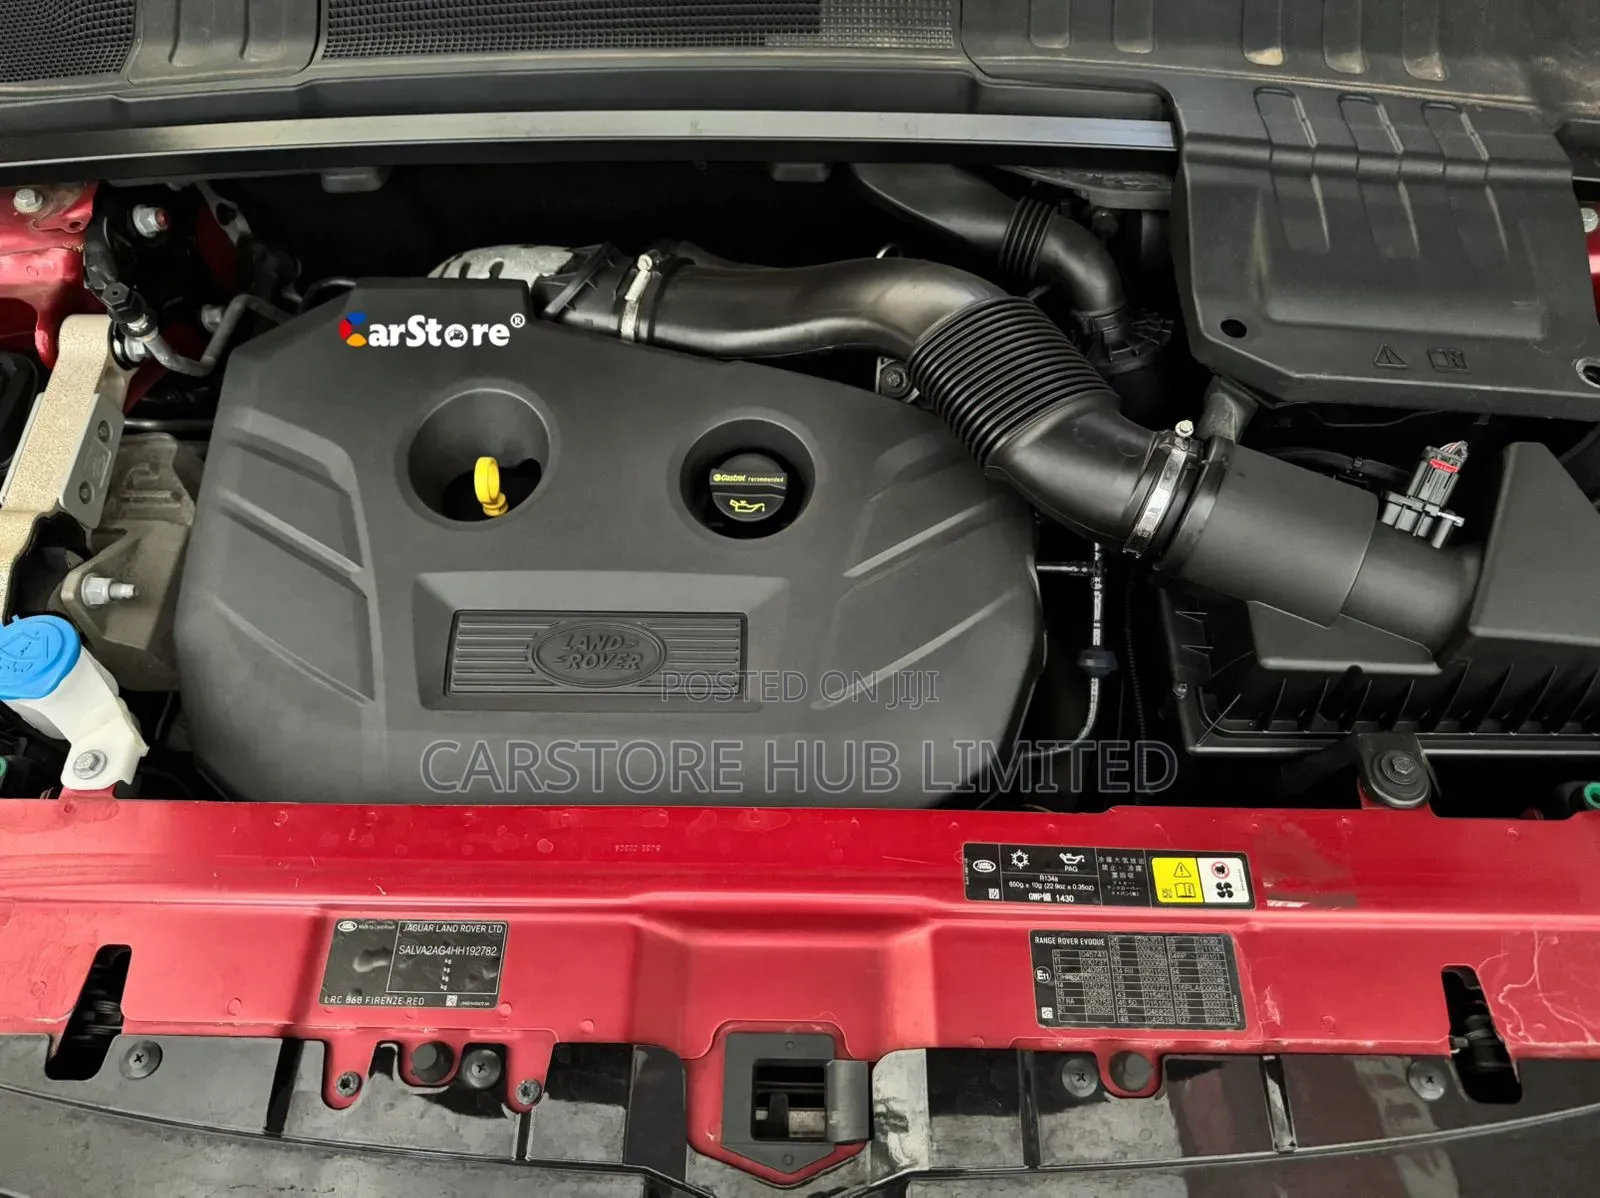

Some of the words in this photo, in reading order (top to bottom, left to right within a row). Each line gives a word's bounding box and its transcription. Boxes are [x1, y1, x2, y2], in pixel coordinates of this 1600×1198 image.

[721, 474, 746, 482] Castrol
[565, 633, 626, 651] LAND
[565, 651, 643, 671] ROVER
[1055, 894, 1075, 903] 1430
[402, 924, 435, 932] JAGUAR
[436, 924, 458, 933] LAND
[460, 925, 487, 933] ROVER
[488, 925, 503, 933] LTD
[398, 944, 498, 956] SALVA2AG4HH192782
[324, 995, 342, 1004] LRC
[365, 996, 402, 1005] FIRENZE
[405, 997, 425, 1006] RED
